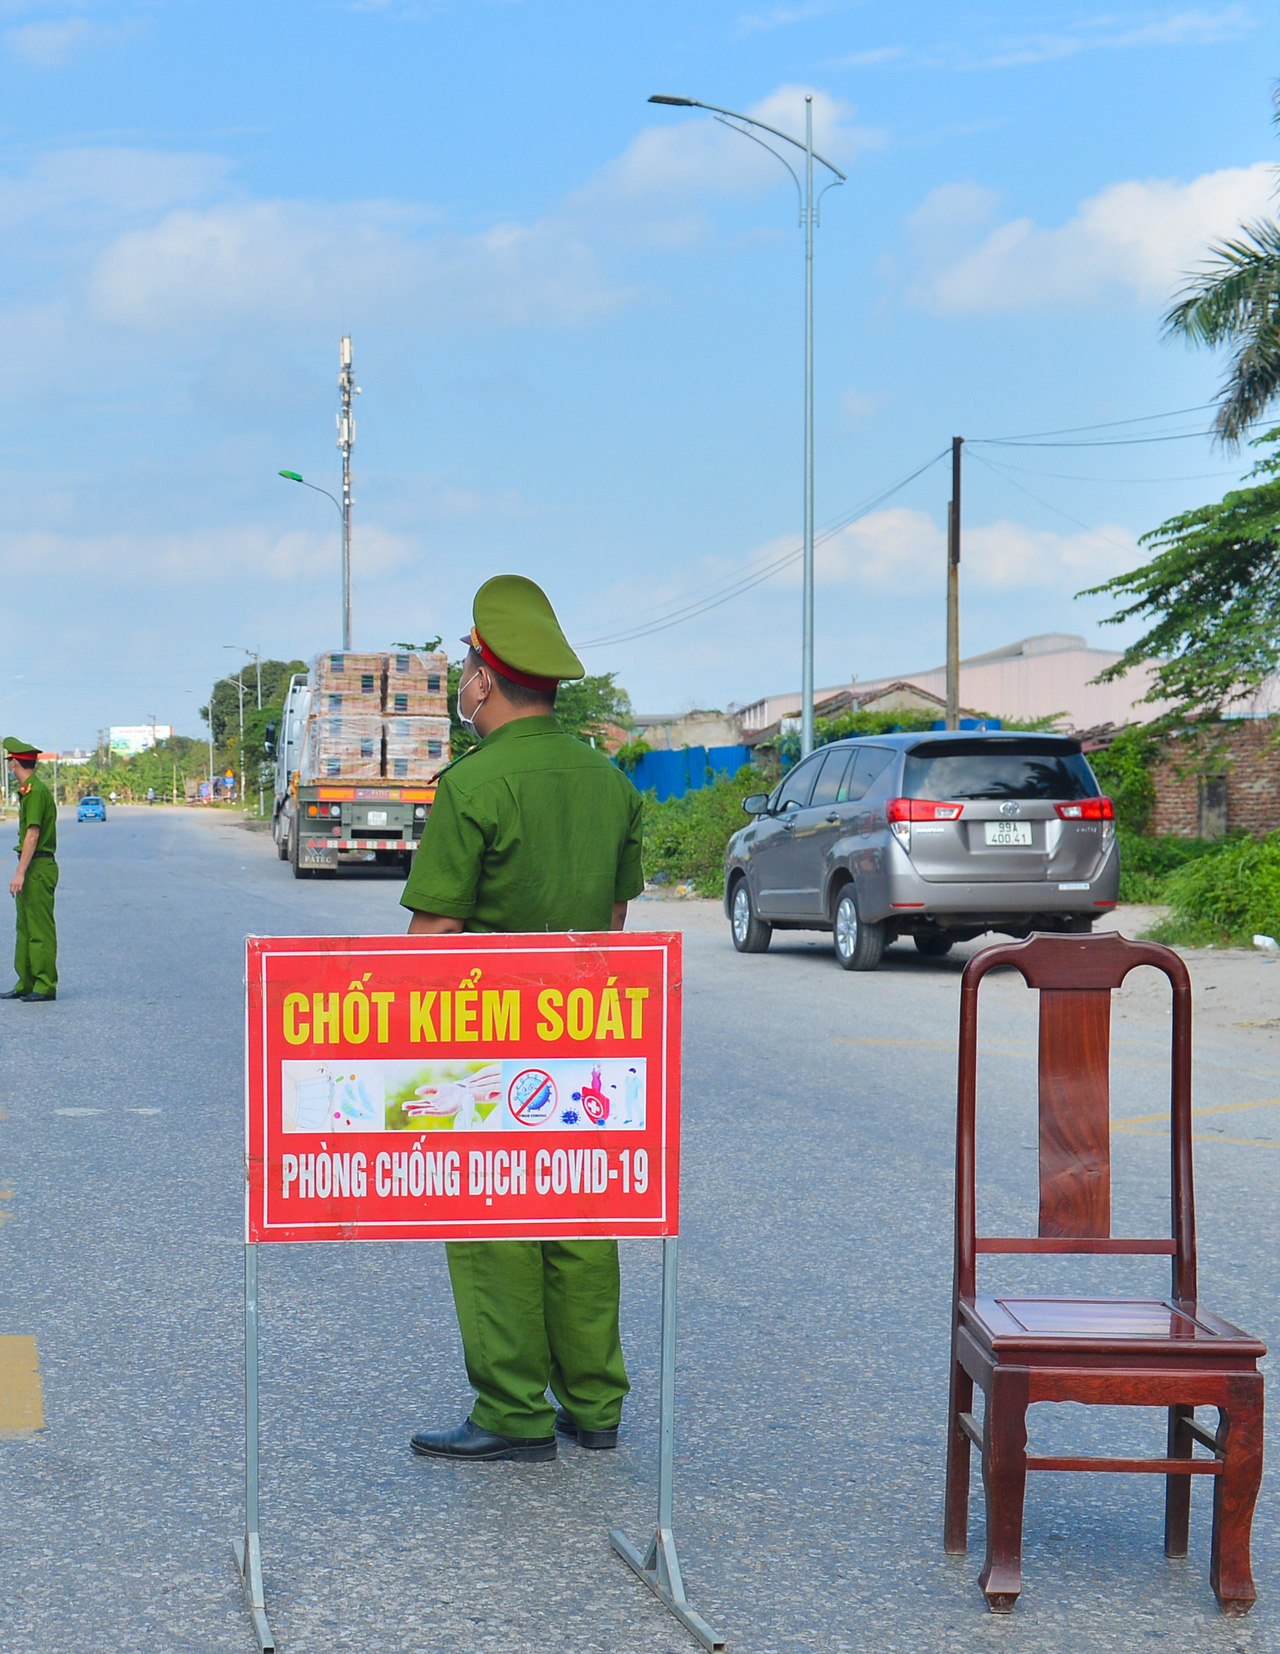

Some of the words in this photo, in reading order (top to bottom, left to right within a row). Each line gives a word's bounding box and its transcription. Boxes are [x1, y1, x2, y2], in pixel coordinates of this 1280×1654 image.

[992, 834, 1026, 844] 400.41
[998, 822, 1018, 832] 99A
[283, 972, 395, 1045] CHỐT
[410, 968, 520, 1042] KIỂM
[536, 976, 649, 1040] SOÁT
[282, 1142, 367, 1198] PHÒNG
[376, 1135, 460, 1198] CHỐNG
[468, 1150, 527, 1206] DỊCH
[535, 1148, 648, 1195] COVID-19
